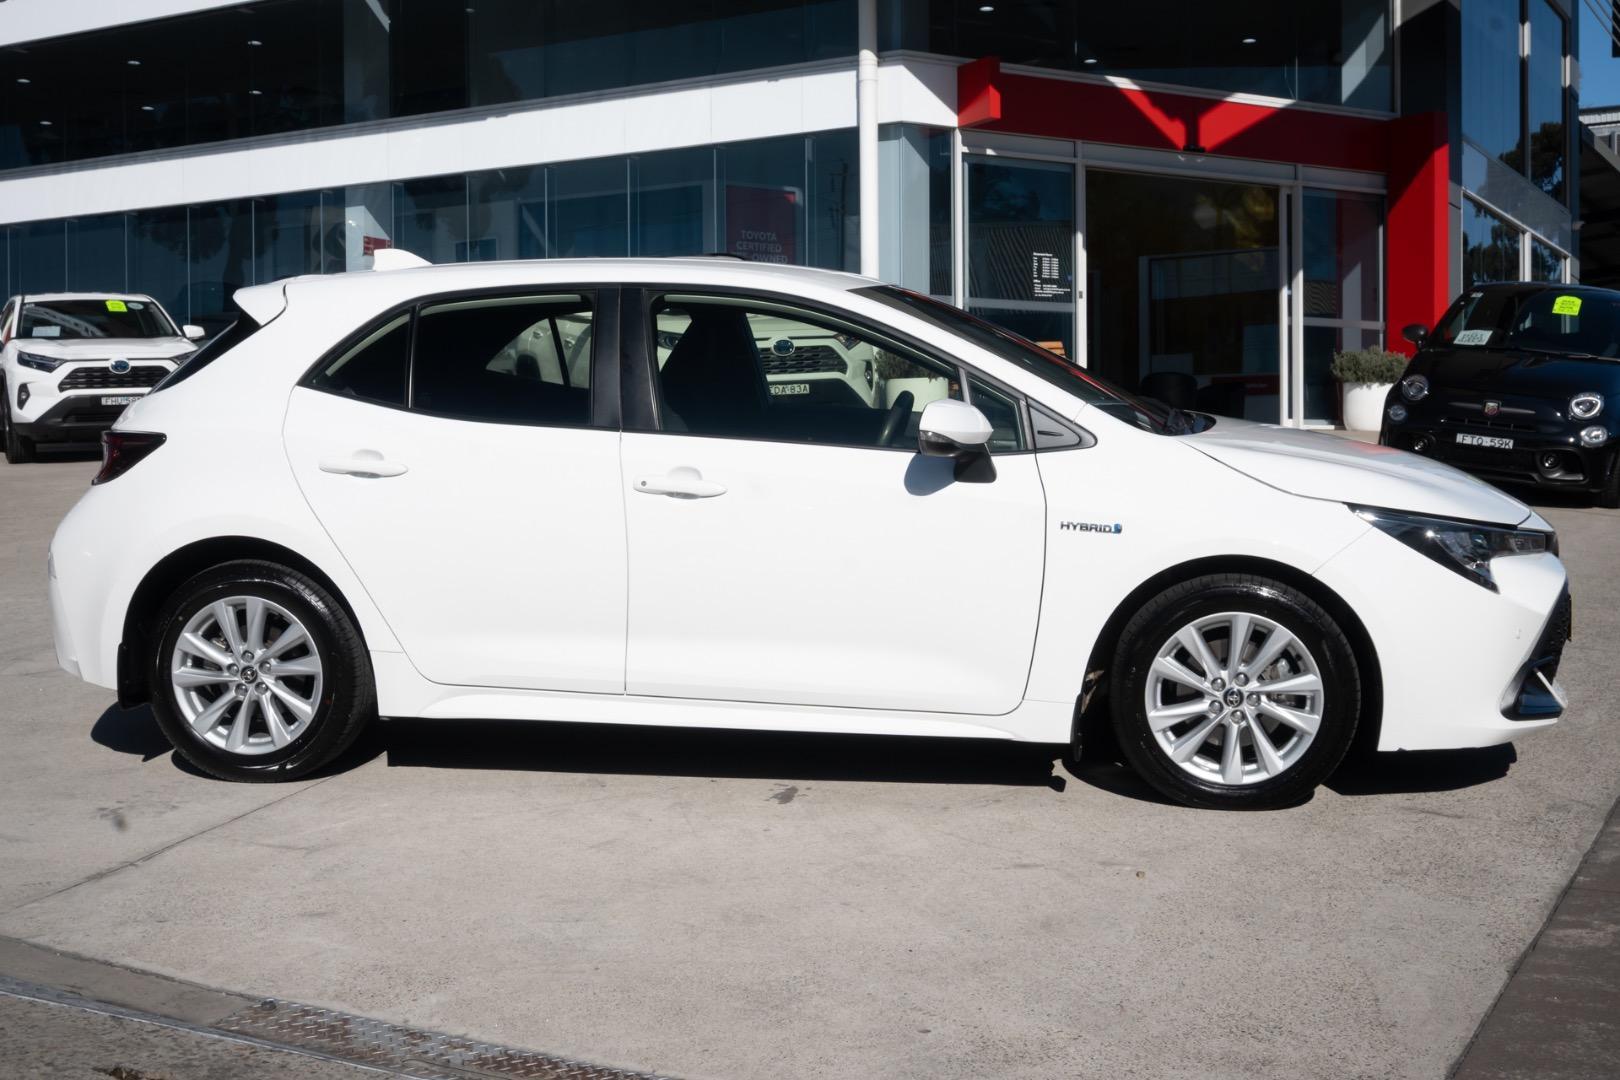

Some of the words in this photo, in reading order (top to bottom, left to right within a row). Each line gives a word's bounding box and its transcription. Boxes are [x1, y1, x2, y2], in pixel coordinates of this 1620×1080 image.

[741, 230, 777, 241] TOYOTA
[736, 241, 782, 253] CERTIFIED
[1060, 521, 1113, 534] HYBRID
